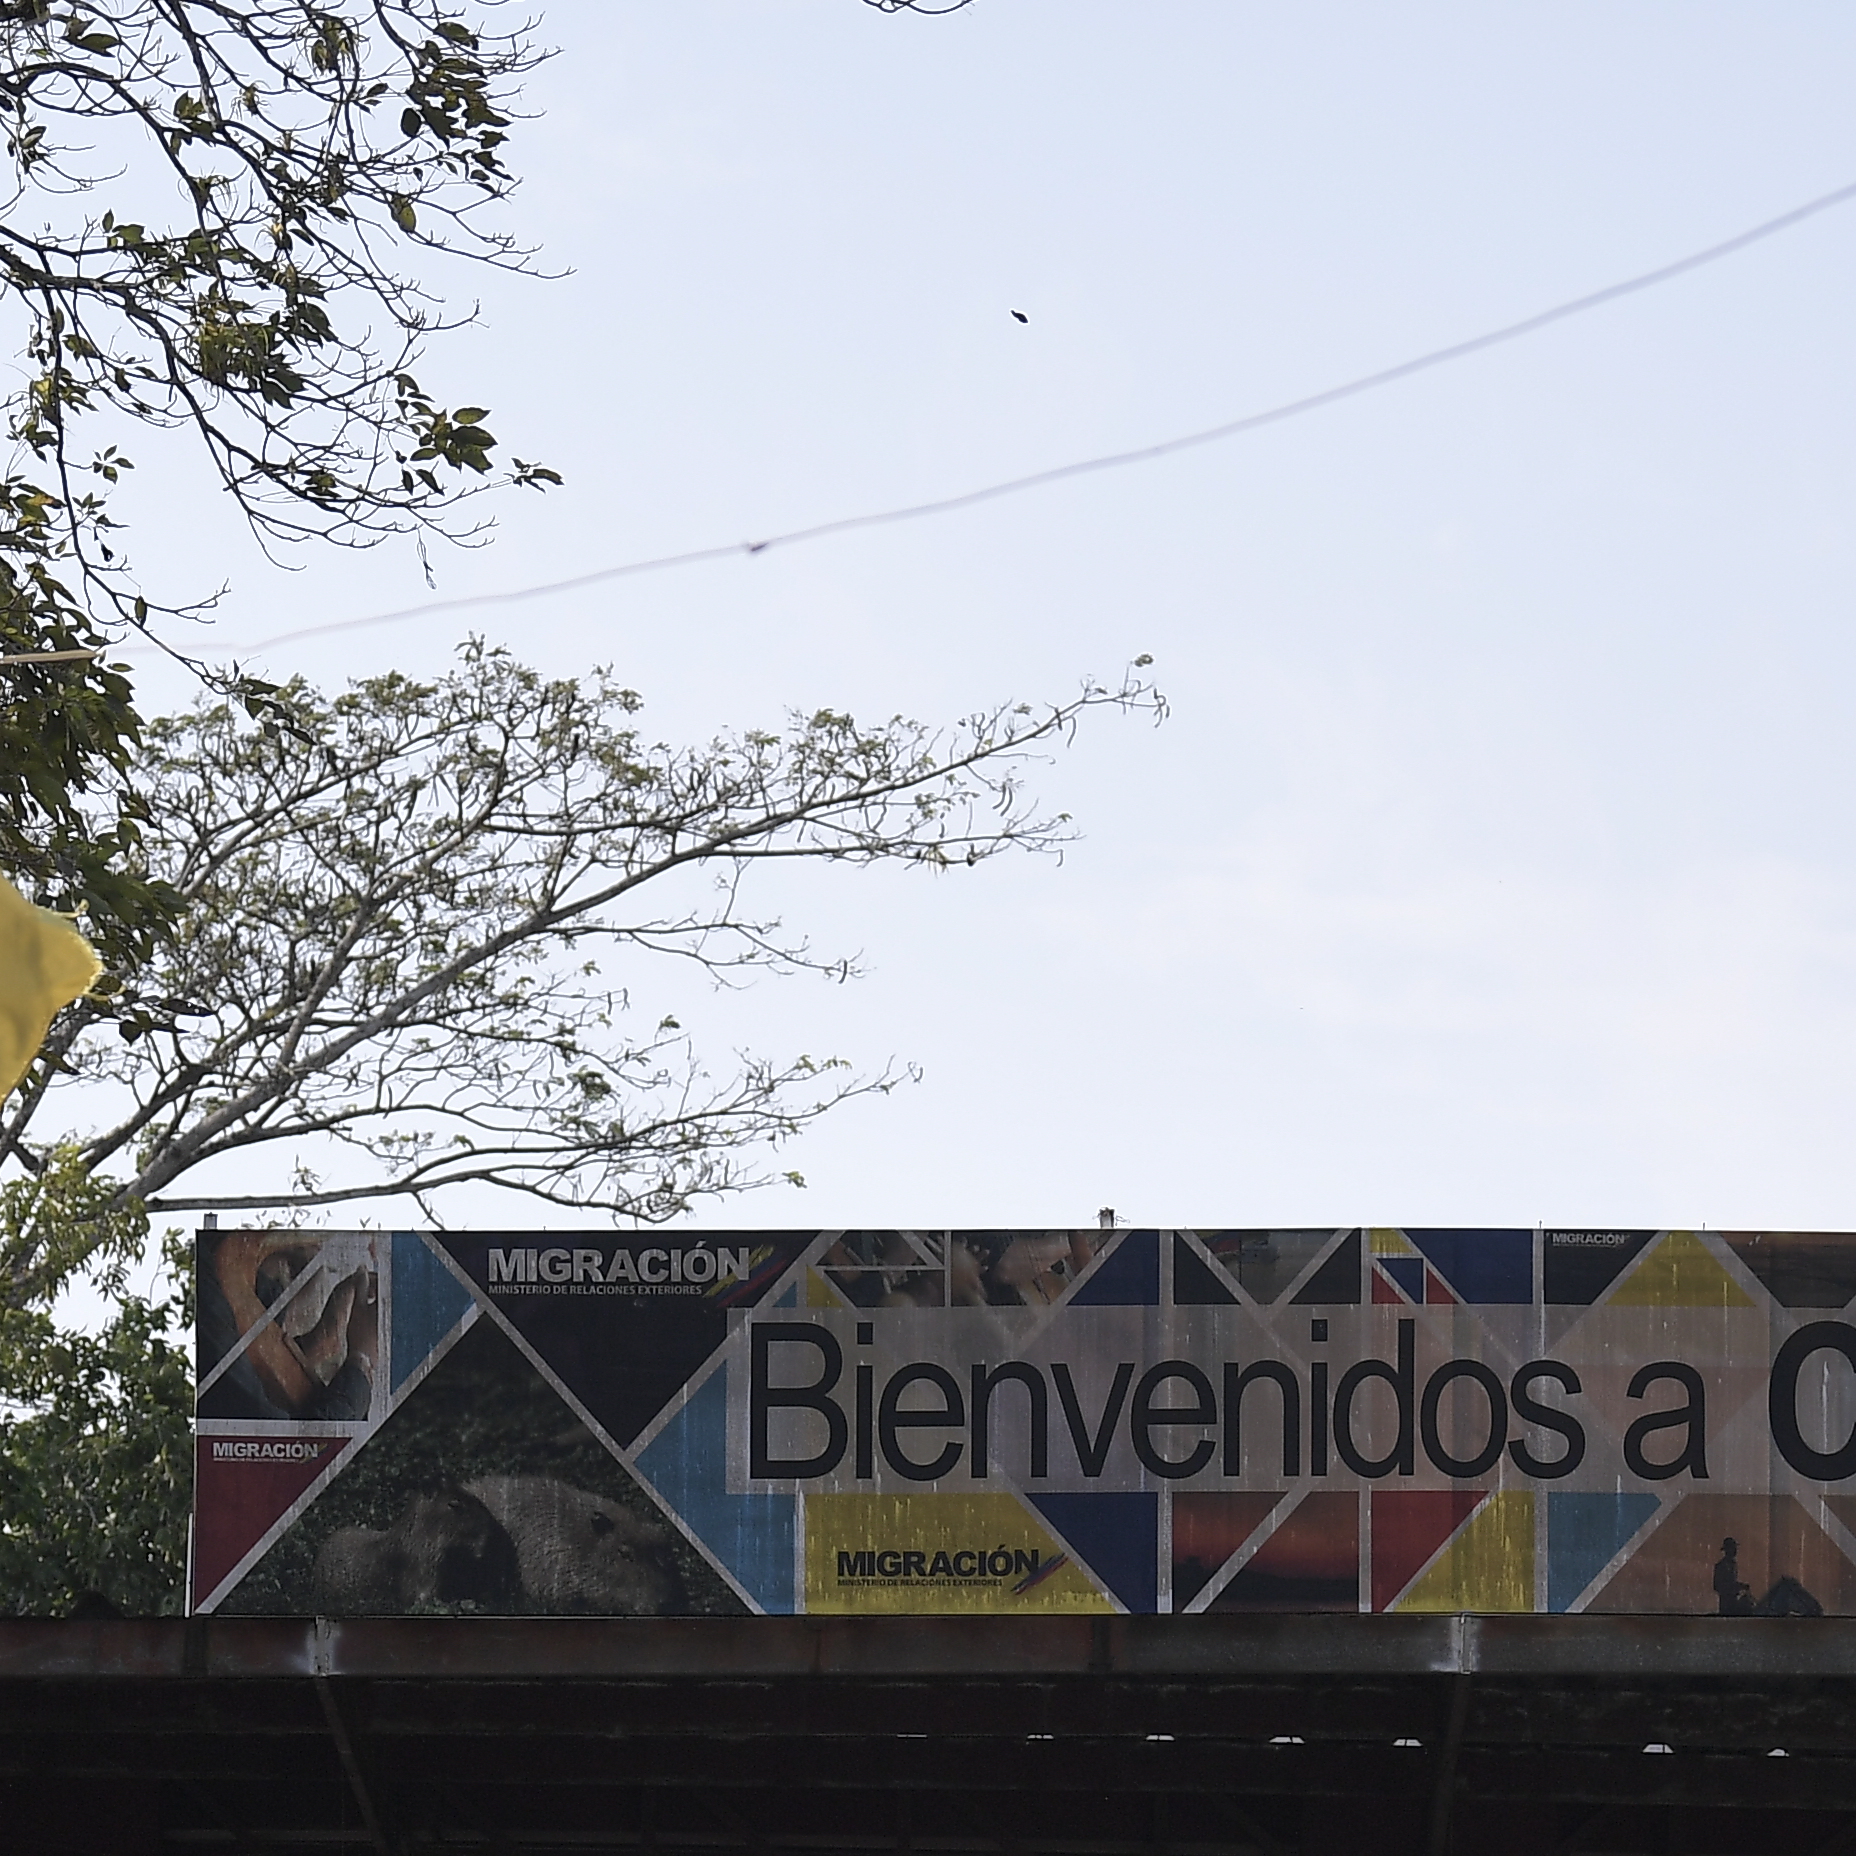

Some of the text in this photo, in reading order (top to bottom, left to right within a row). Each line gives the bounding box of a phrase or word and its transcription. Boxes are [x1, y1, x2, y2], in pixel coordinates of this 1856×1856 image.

[1552, 1232, 1624, 1244] MIGRACIÓN
[488, 1240, 750, 1283] MIGRACIÓN
[488, 1285, 702, 1296] MINISTERIO DE RELACIONES EXTERIORES
[749, 1318, 1586, 1482] Bienvenidos
[1623, 1359, 1711, 1482] a
[213, 1441, 319, 1458] MIGRACIÓN
[838, 1544, 1039, 1577] MIGRACIÓN
